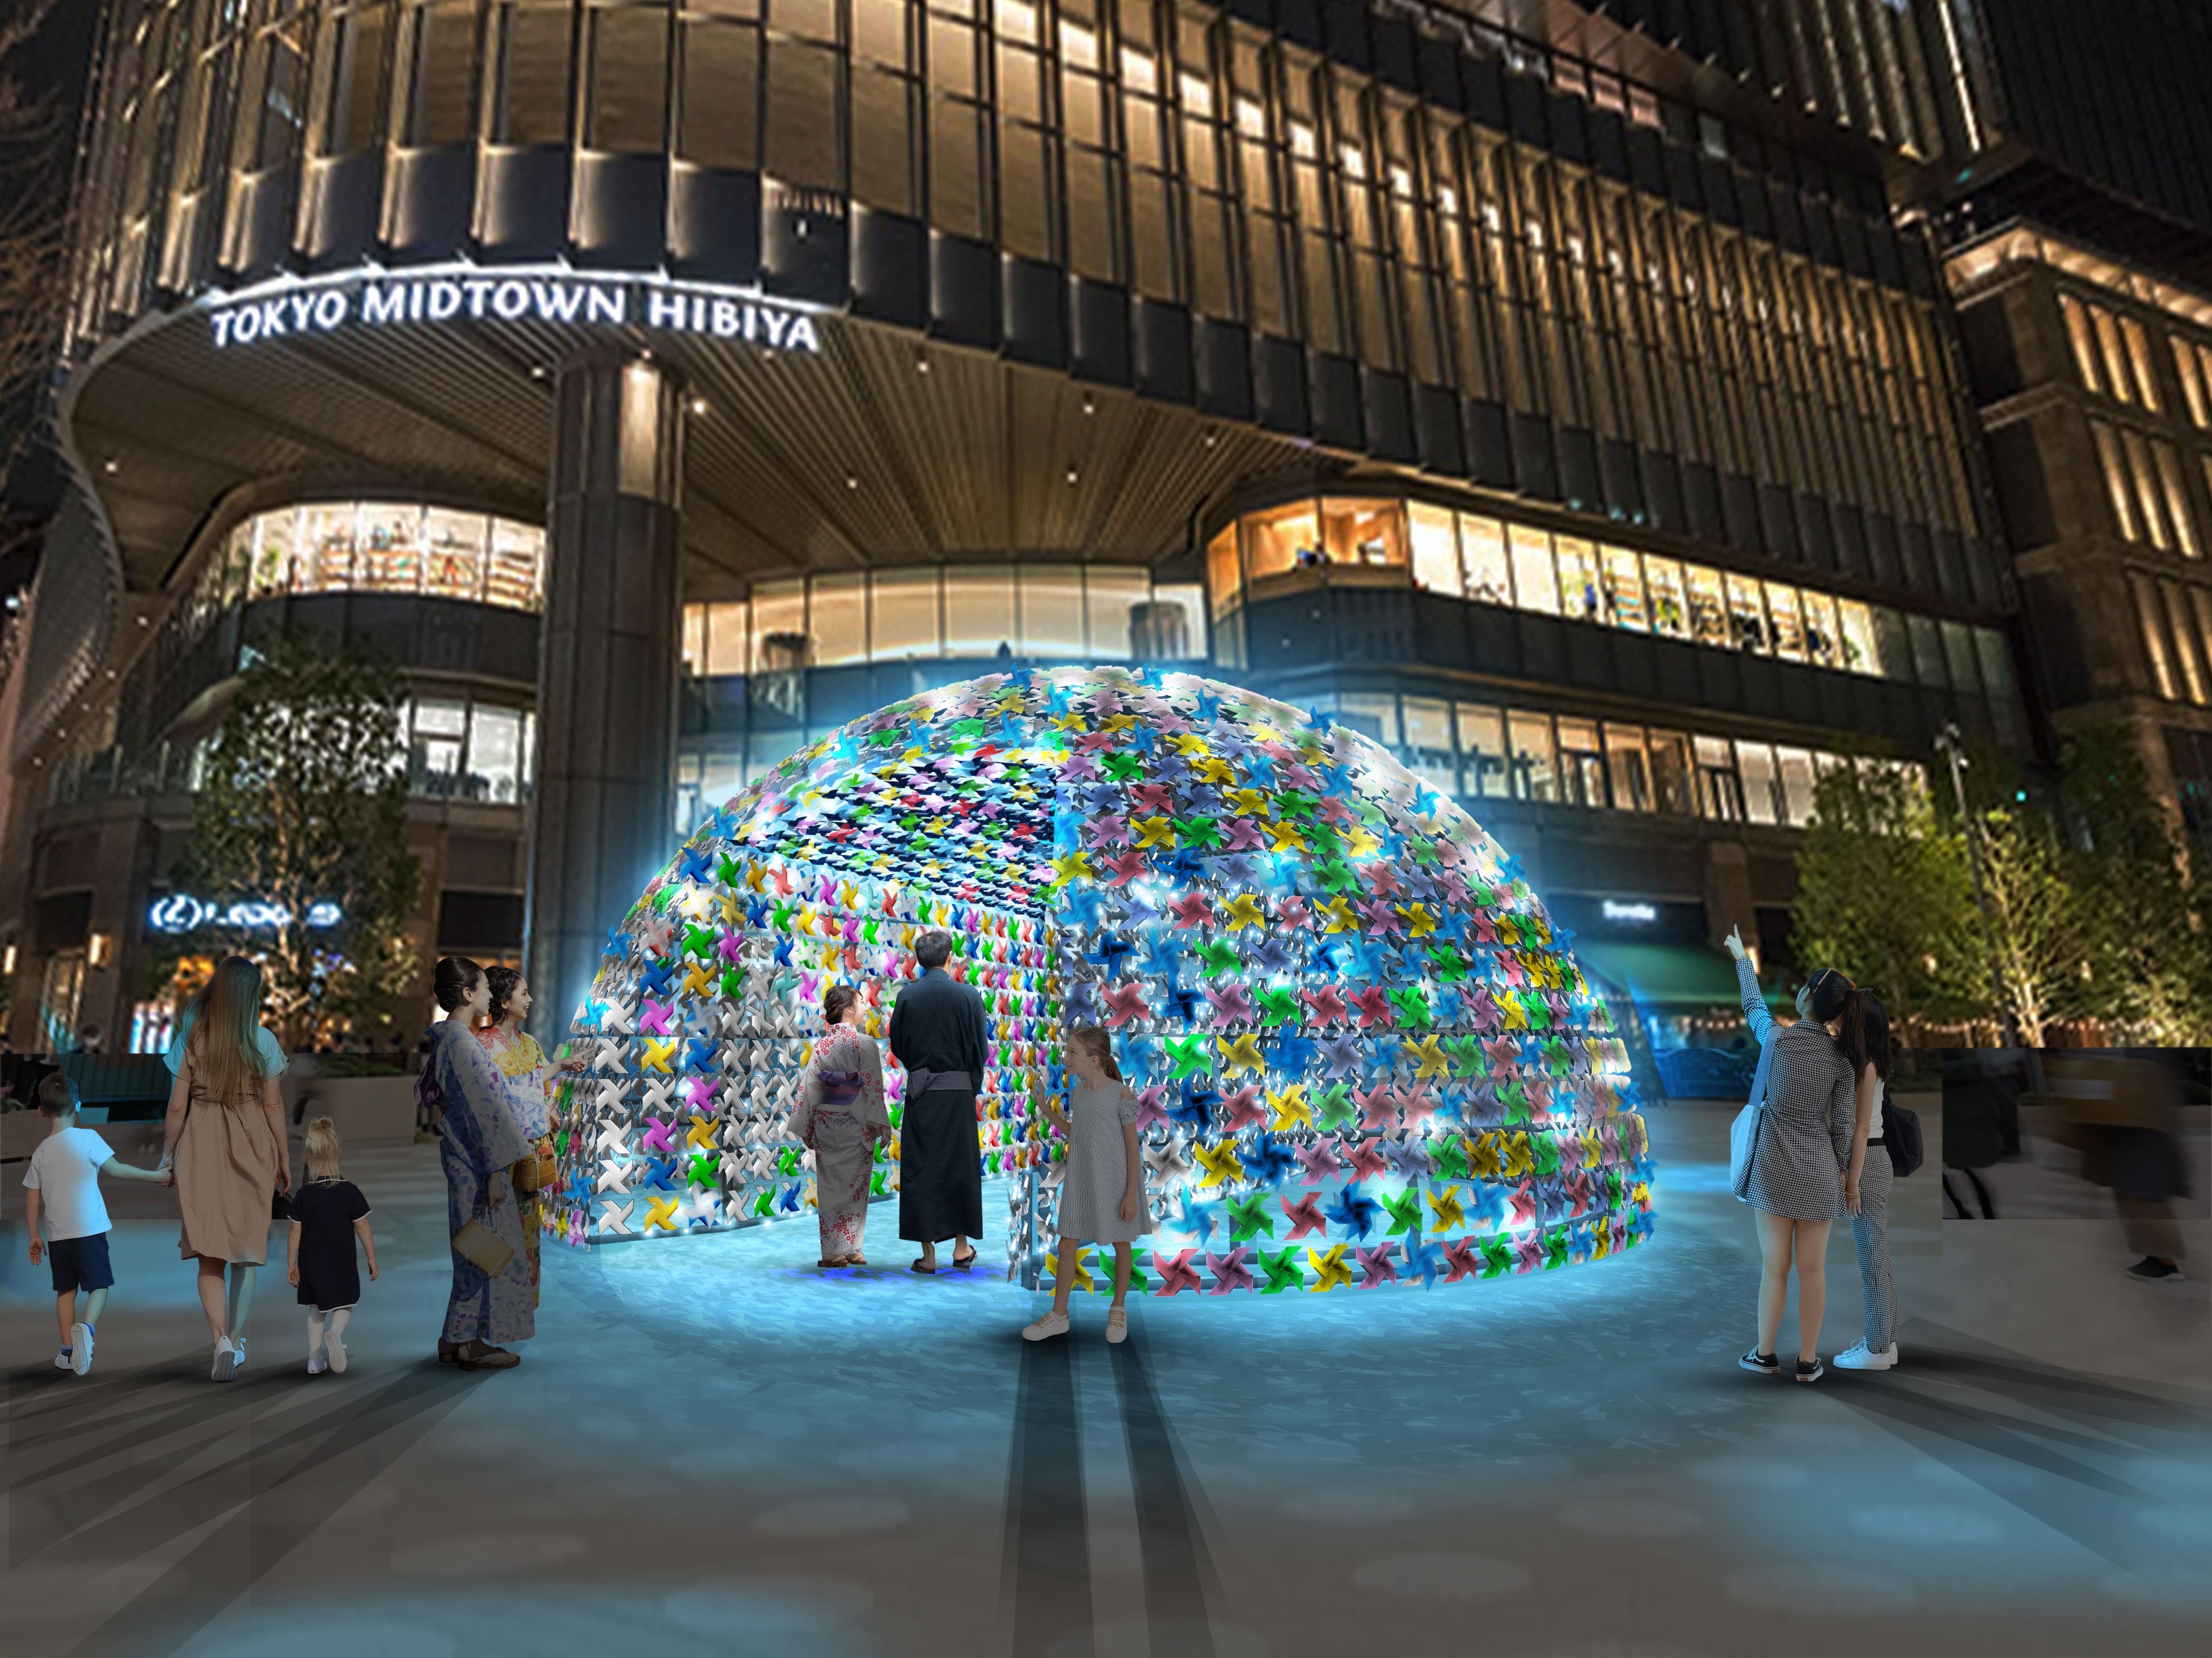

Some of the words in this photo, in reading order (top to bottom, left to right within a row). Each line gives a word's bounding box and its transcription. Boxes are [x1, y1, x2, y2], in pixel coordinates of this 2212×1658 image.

[212, 290, 347, 347] TOKYO
[362, 280, 625, 323] MIDTOWN
[650, 290, 819, 353] HIBIYA
